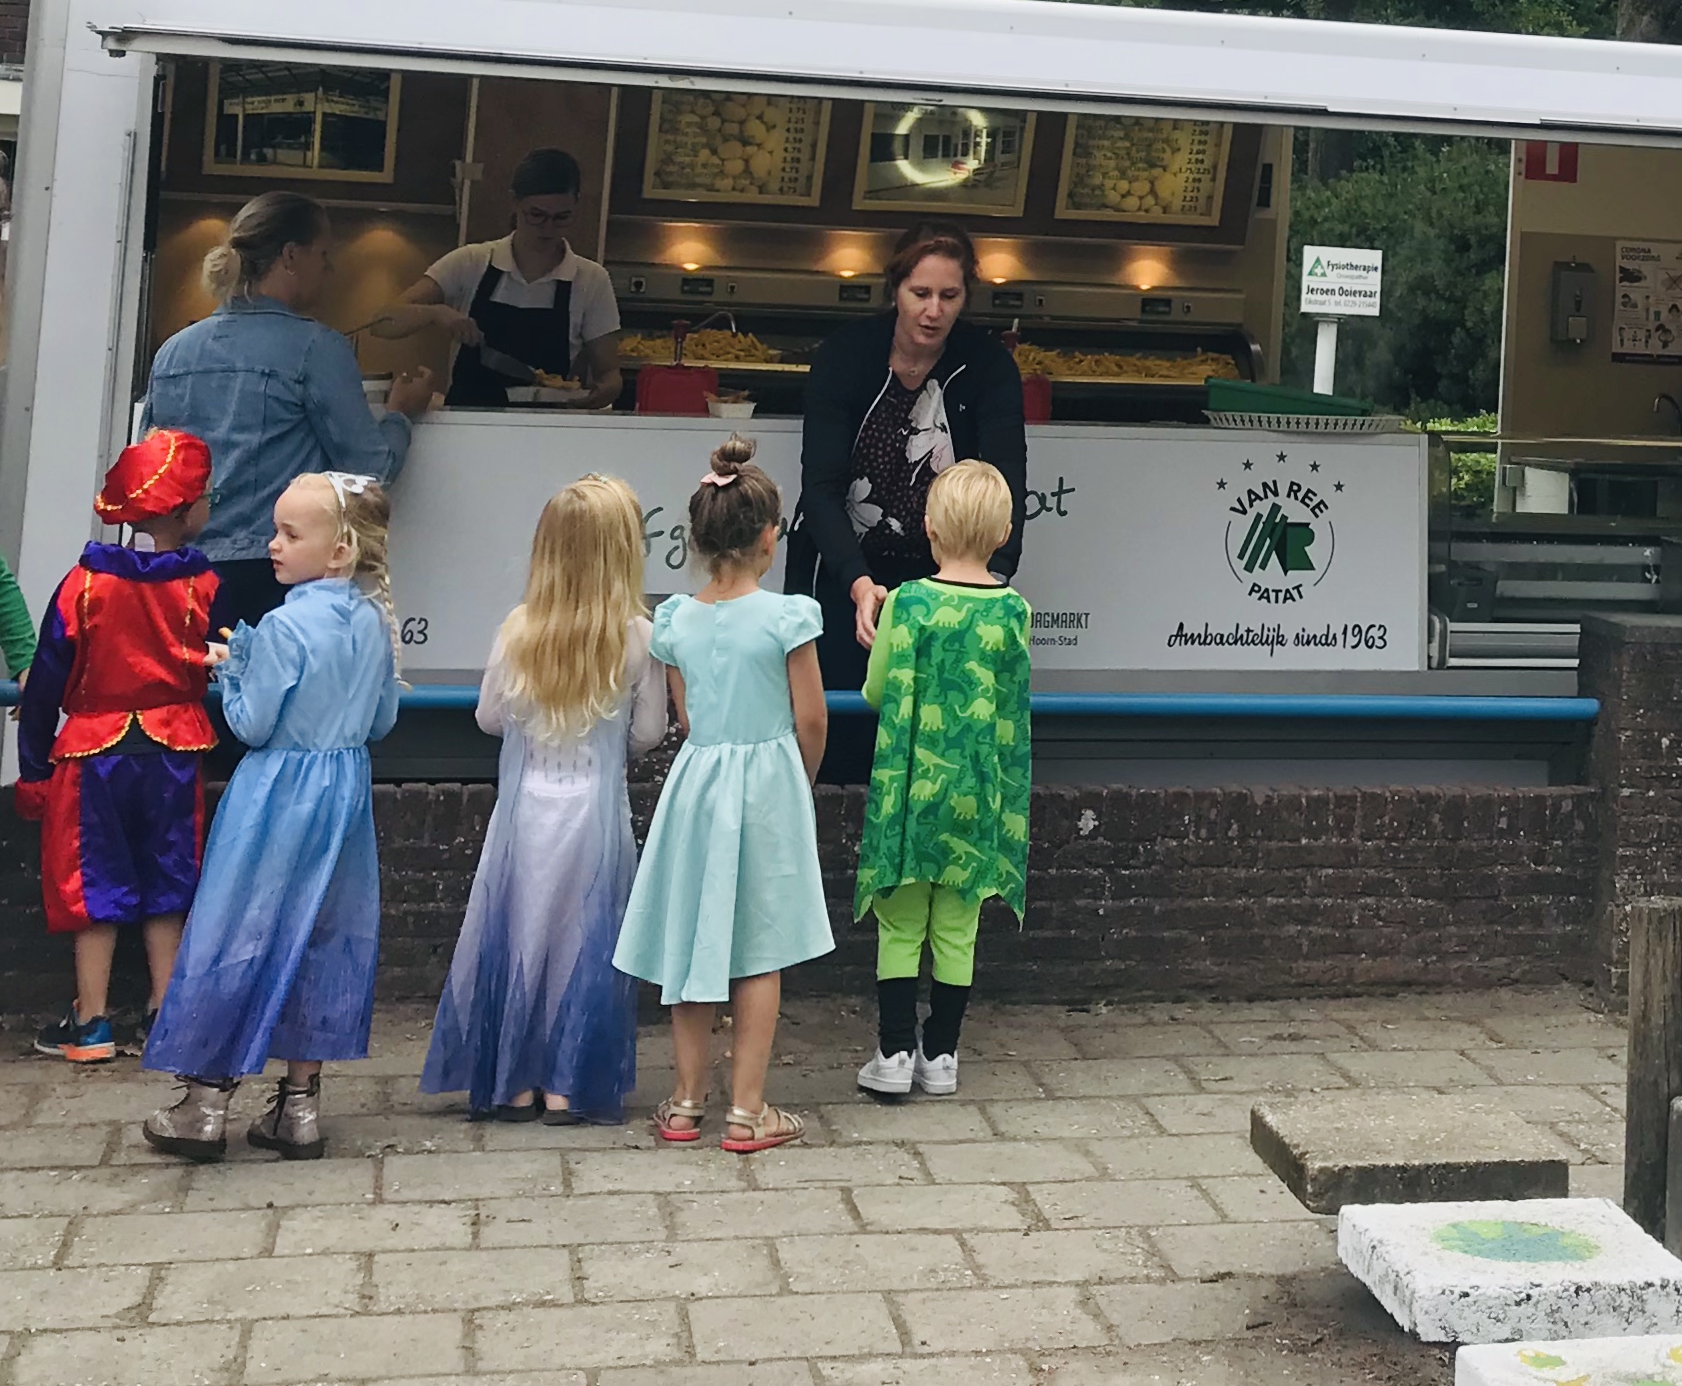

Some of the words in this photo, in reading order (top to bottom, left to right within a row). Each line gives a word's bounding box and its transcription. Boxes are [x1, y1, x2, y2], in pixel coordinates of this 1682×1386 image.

[1326, 260, 1379, 274] Fysiotherapie
[1306, 284, 1336, 296] Jeroen
[1338, 286, 1377, 299] Ooievaar
[1229, 479, 1279, 516] VAN
[1286, 480, 1329, 519] REE
[1248, 582, 1304, 604] PATAT
[1030, 635, 1078, 646] Hoorn-Stad
[1167, 622, 1288, 657] Ambachtelijk
[1293, 623, 1337, 647] sinds
[1341, 623, 1388, 649] 1963
